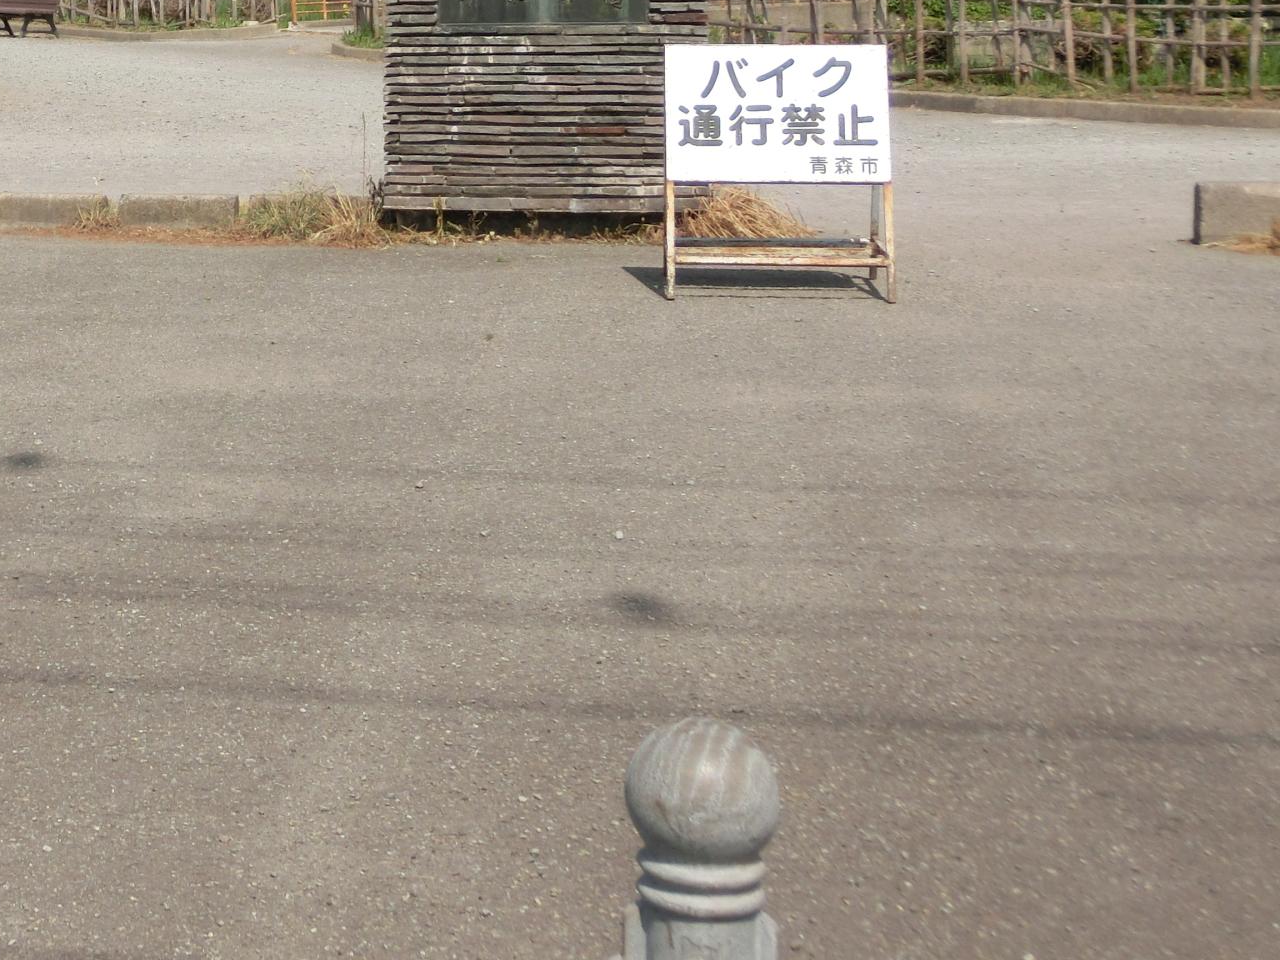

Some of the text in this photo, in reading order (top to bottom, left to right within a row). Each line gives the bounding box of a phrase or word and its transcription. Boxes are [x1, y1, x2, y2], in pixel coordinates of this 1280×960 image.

[700, 56, 853, 99] バイク
[677, 103, 879, 147] 通行禁止
[809, 156, 879, 175] 青森市
